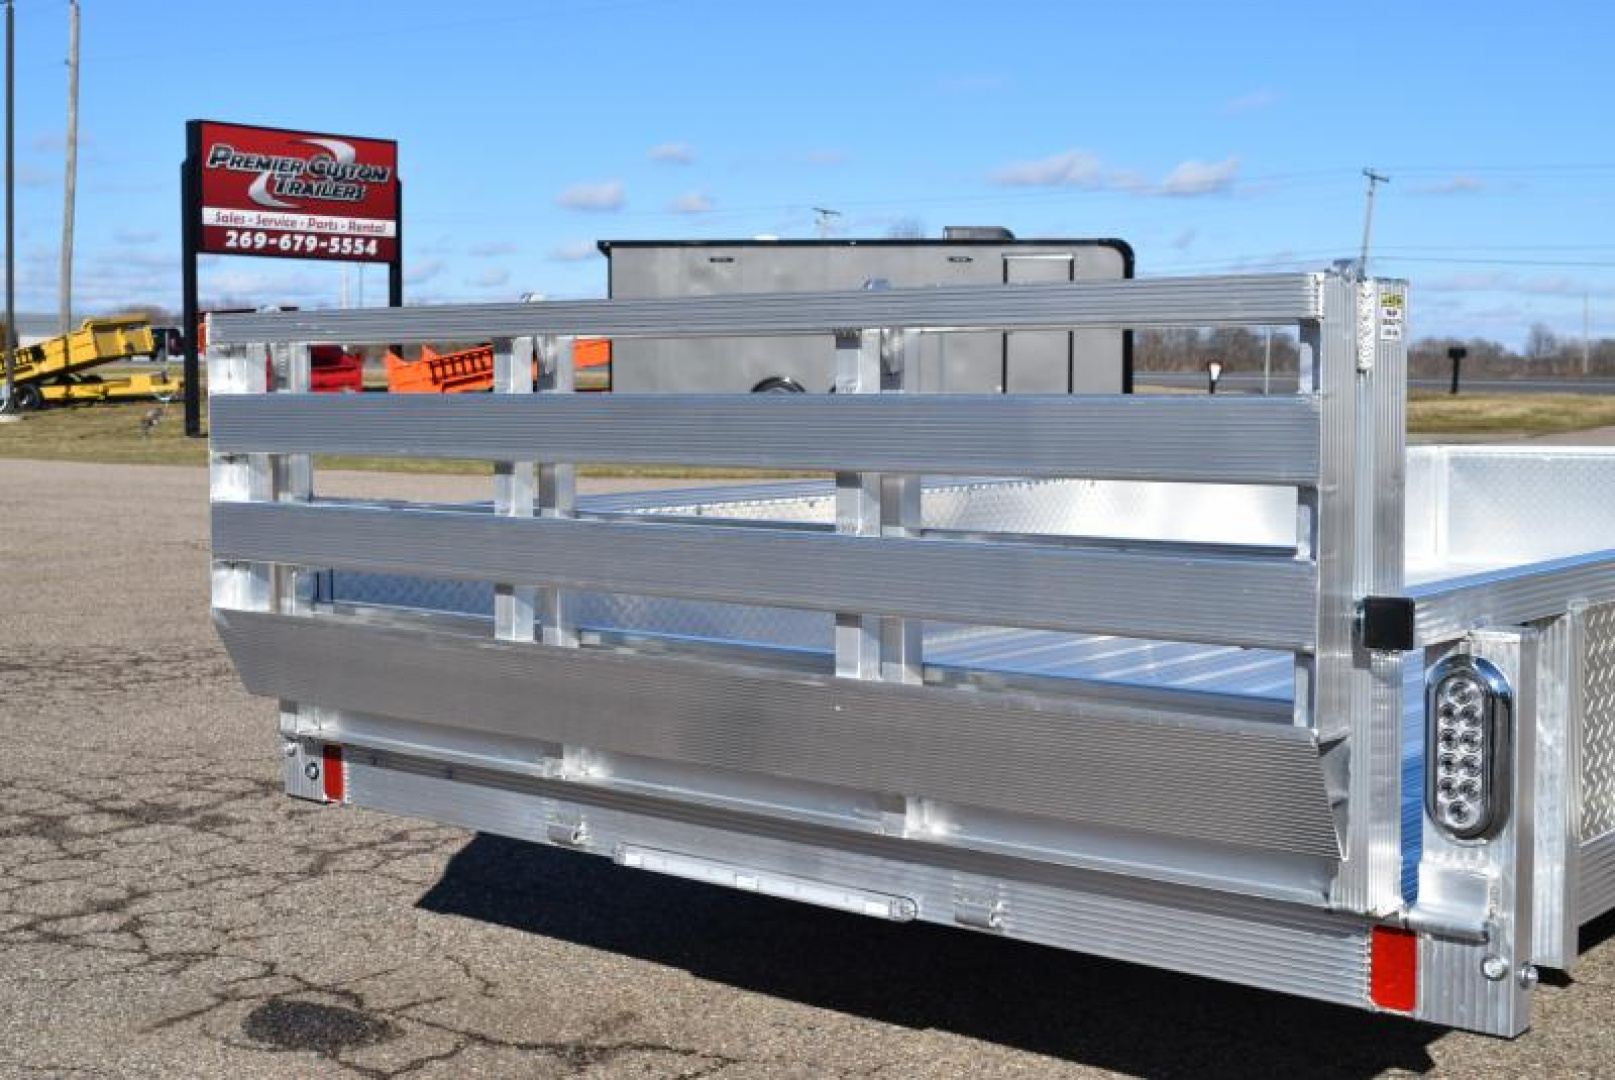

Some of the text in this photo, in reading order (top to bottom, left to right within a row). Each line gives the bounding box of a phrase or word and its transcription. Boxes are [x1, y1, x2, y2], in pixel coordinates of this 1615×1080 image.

[207, 144, 389, 182] PREMIER CUSTOM
[274, 174, 365, 201] TRAILERS
[215, 211, 386, 233] Sales Service Parts Rental
[225, 230, 378, 255] 269-679-5554
